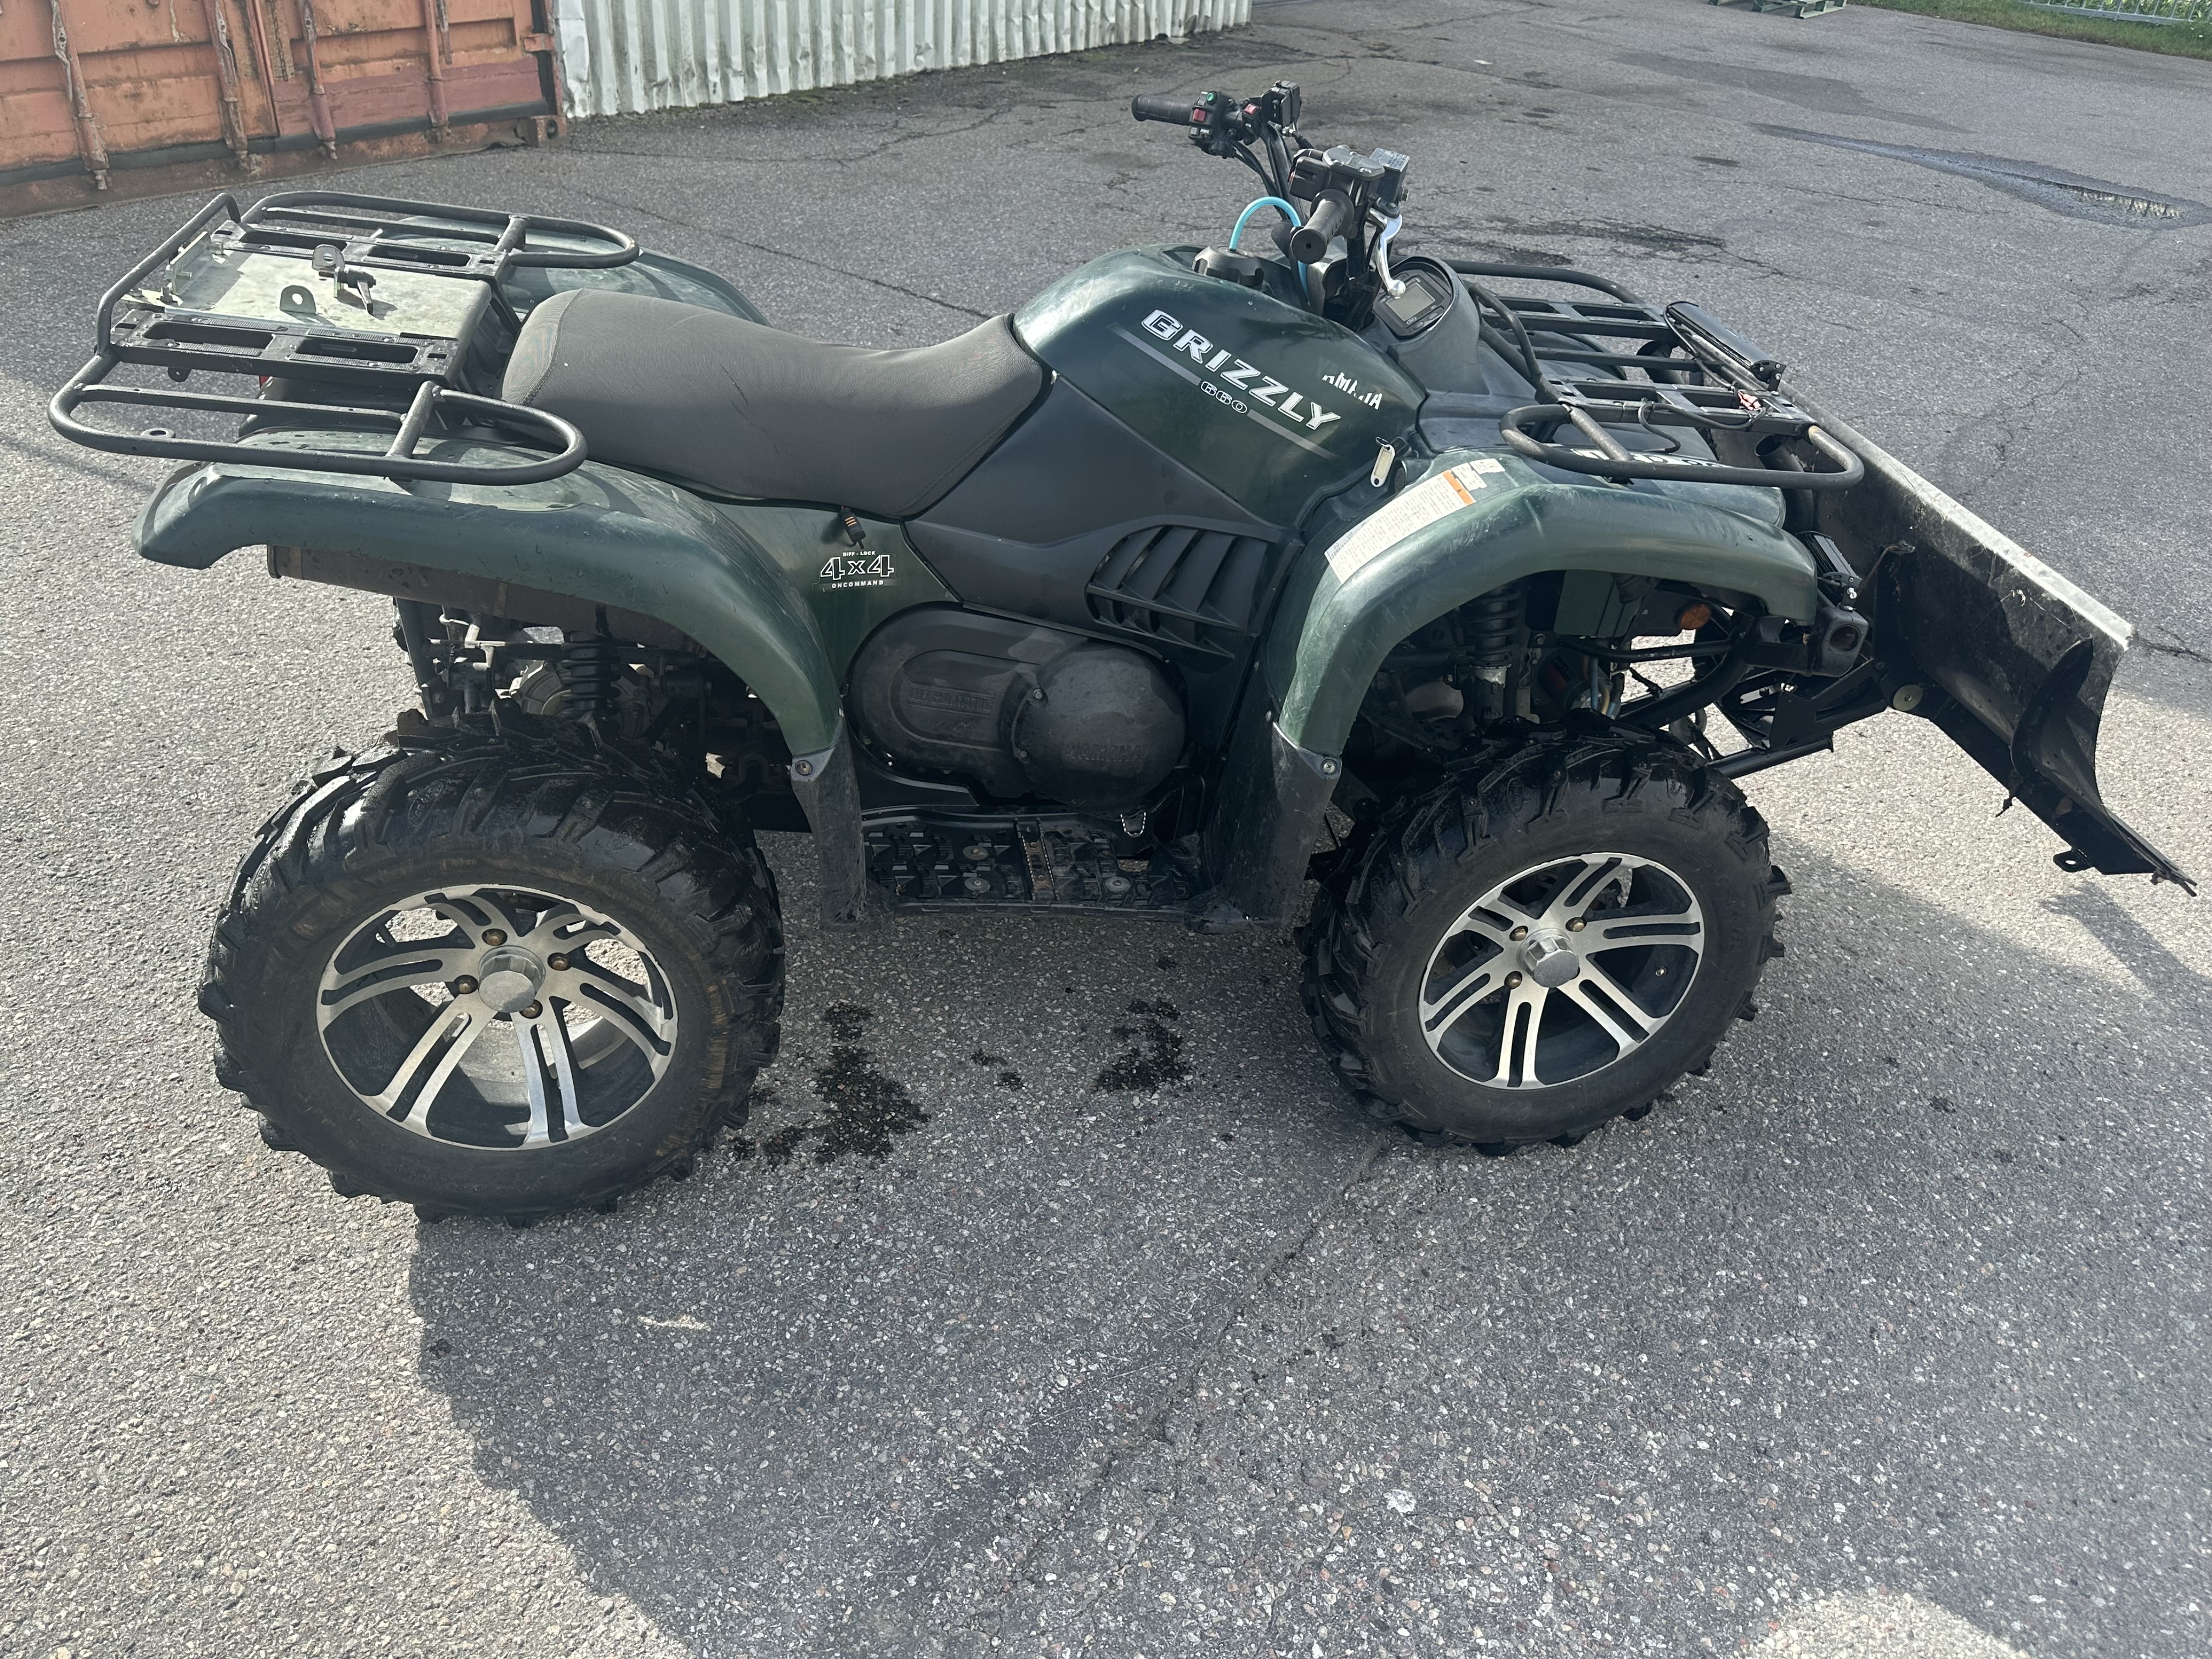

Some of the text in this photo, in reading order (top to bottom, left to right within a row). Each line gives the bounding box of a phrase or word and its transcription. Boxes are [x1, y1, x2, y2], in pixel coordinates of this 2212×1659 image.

[1141, 308, 1341, 431] GRIZZLY
[1200, 381, 1248, 414] 660
[820, 554, 894, 580] 4x4
[832, 580, 884, 589] ONCOMMAND
[1067, 741, 1142, 762] YAMAHA
